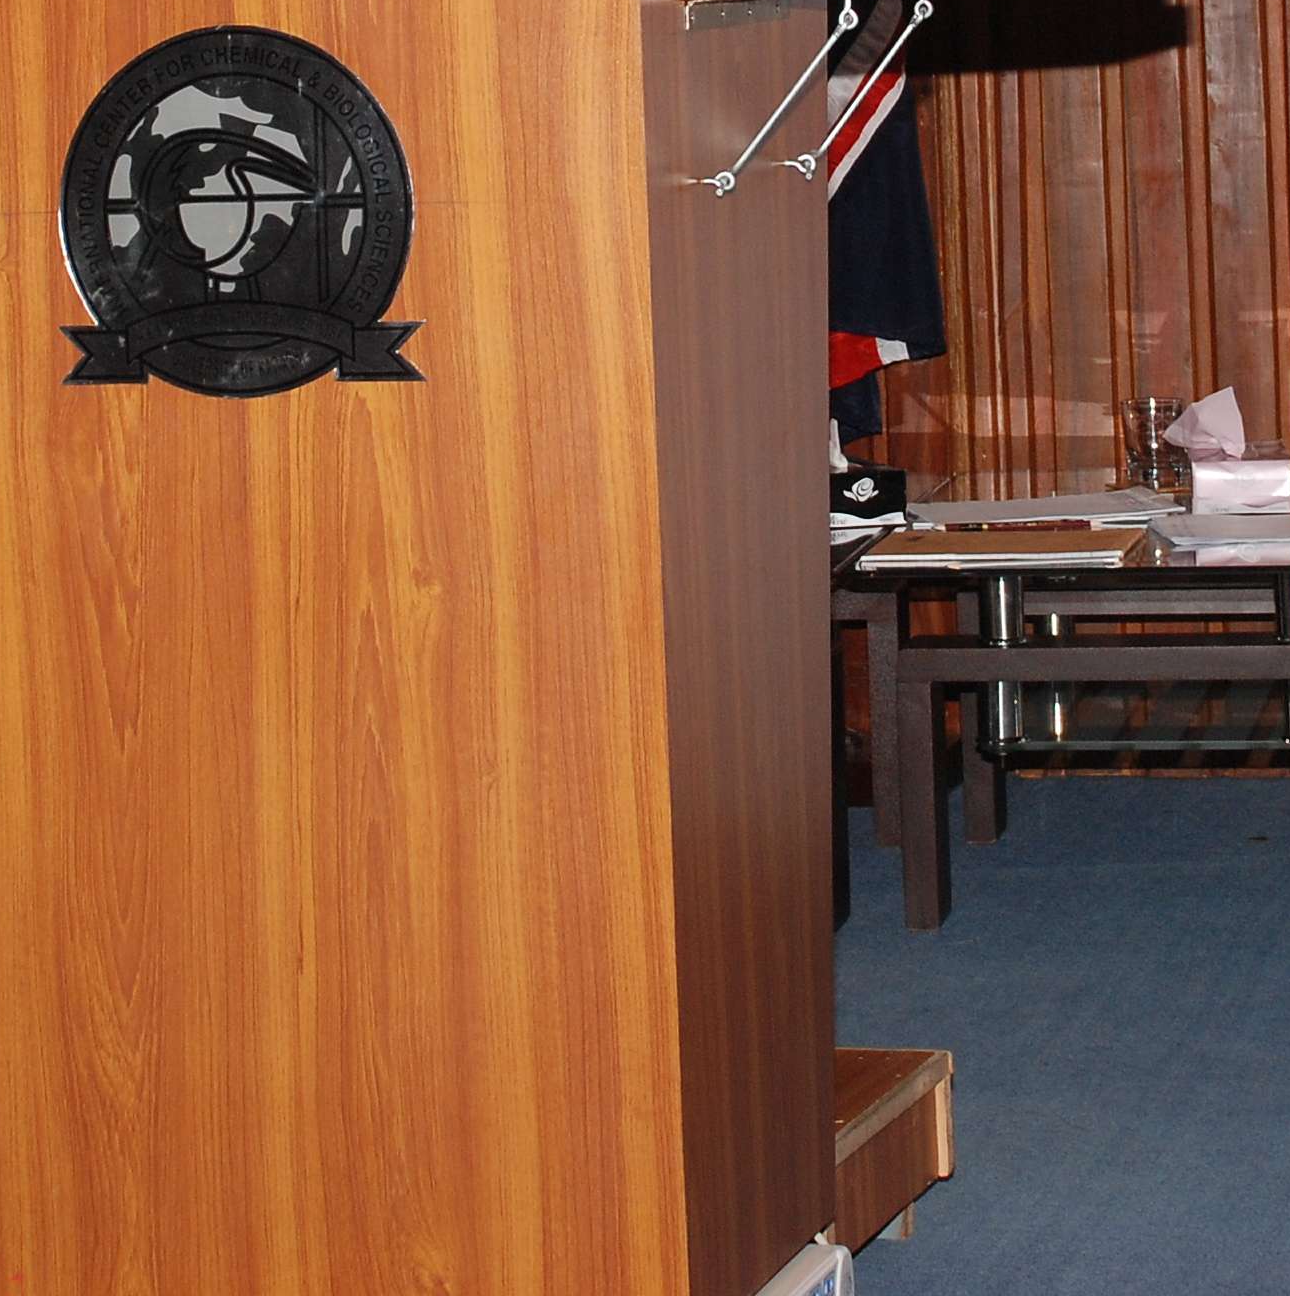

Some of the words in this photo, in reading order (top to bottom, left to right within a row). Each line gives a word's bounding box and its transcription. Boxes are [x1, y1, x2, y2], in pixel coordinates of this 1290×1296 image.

[154, 53, 198, 86] FOR
[200, 45, 303, 80] CHEMICAL
[307, 71, 321, 90] &
[96, 79, 156, 151] CENTER
[323, 83, 394, 204] BIOLOGICAL
[347, 210, 394, 315] SCIENCES
